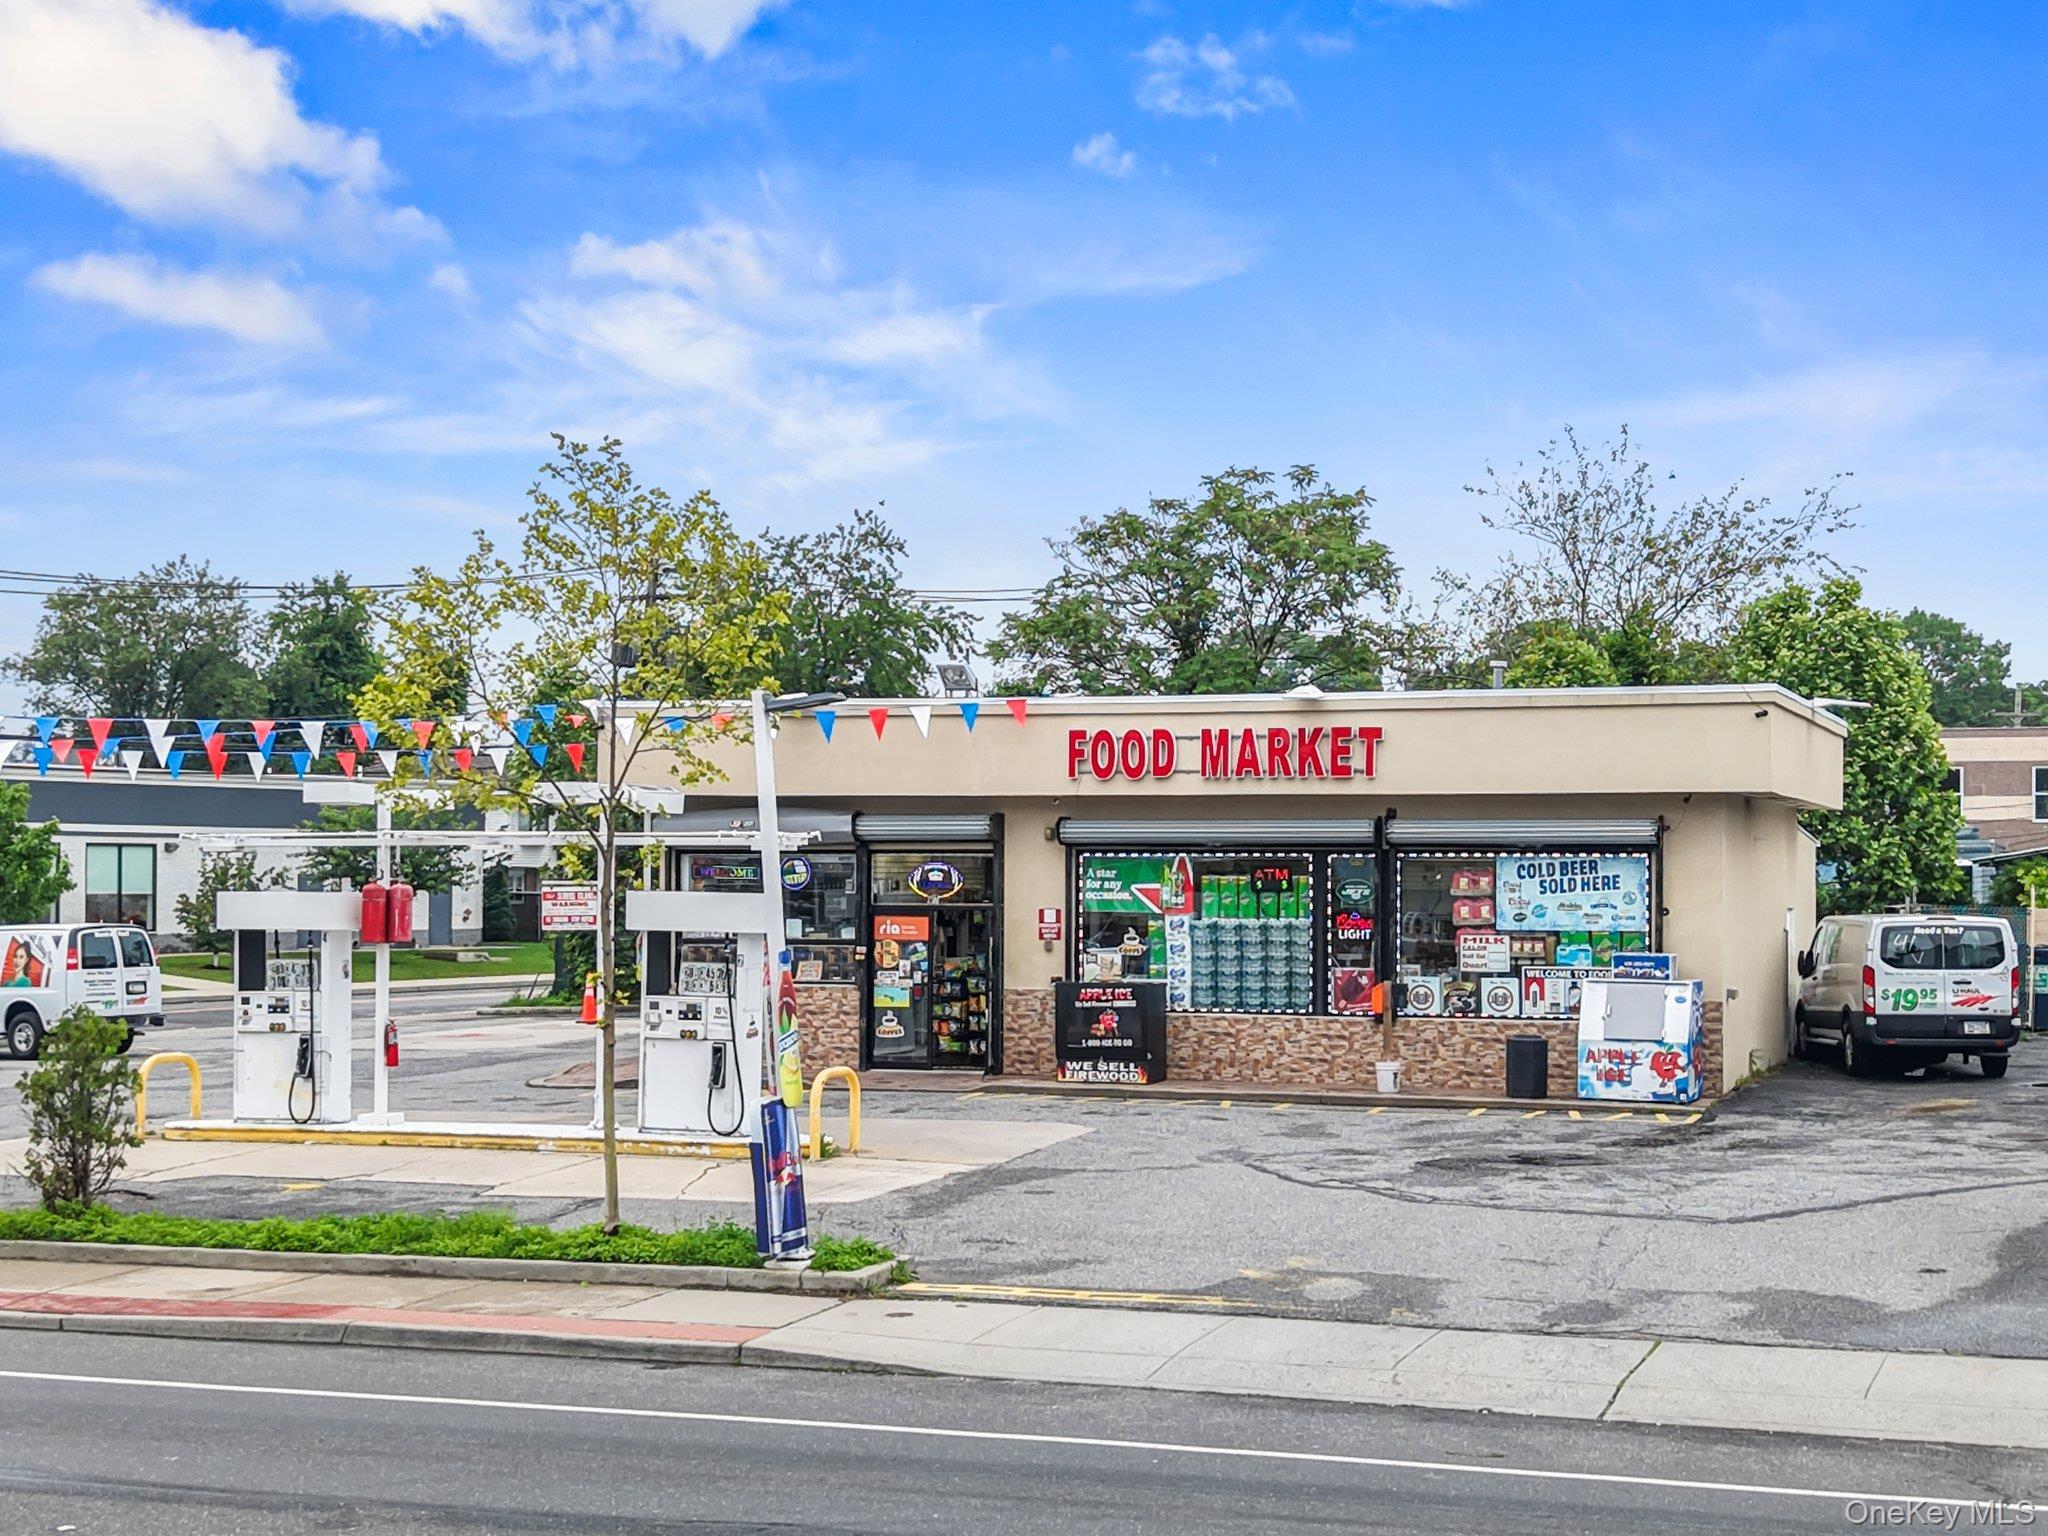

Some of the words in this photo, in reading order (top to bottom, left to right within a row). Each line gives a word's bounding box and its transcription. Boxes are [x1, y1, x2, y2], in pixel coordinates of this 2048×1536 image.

[1067, 728, 1177, 780] FOOD
[1200, 726, 1384, 779] MARKET
[1087, 868, 1095, 878] A
[1096, 869, 1117, 878] star
[1255, 868, 1289, 880] ATM
[1516, 862, 1556, 879] COLD
[1559, 859, 1599, 877] BEER
[1086, 879, 1102, 889] for
[1103, 881, 1122, 892] any
[1539, 877, 1577, 895] SOLD
[1580, 874, 1621, 892] HERE
[1085, 890, 1133, 900] occasion.
[879, 919, 900, 935] ria
[1338, 929, 1371, 940] LIGHT
[1526, 970, 1571, 979] WELCOME
[1573, 970, 1587, 979] TO
[1114, 988, 1133, 1000] ICE
[1065, 1061, 1093, 1071] WE
[1097, 1061, 1138, 1072] SELL
[1065, 1071, 1139, 1081] FIREWOOD
